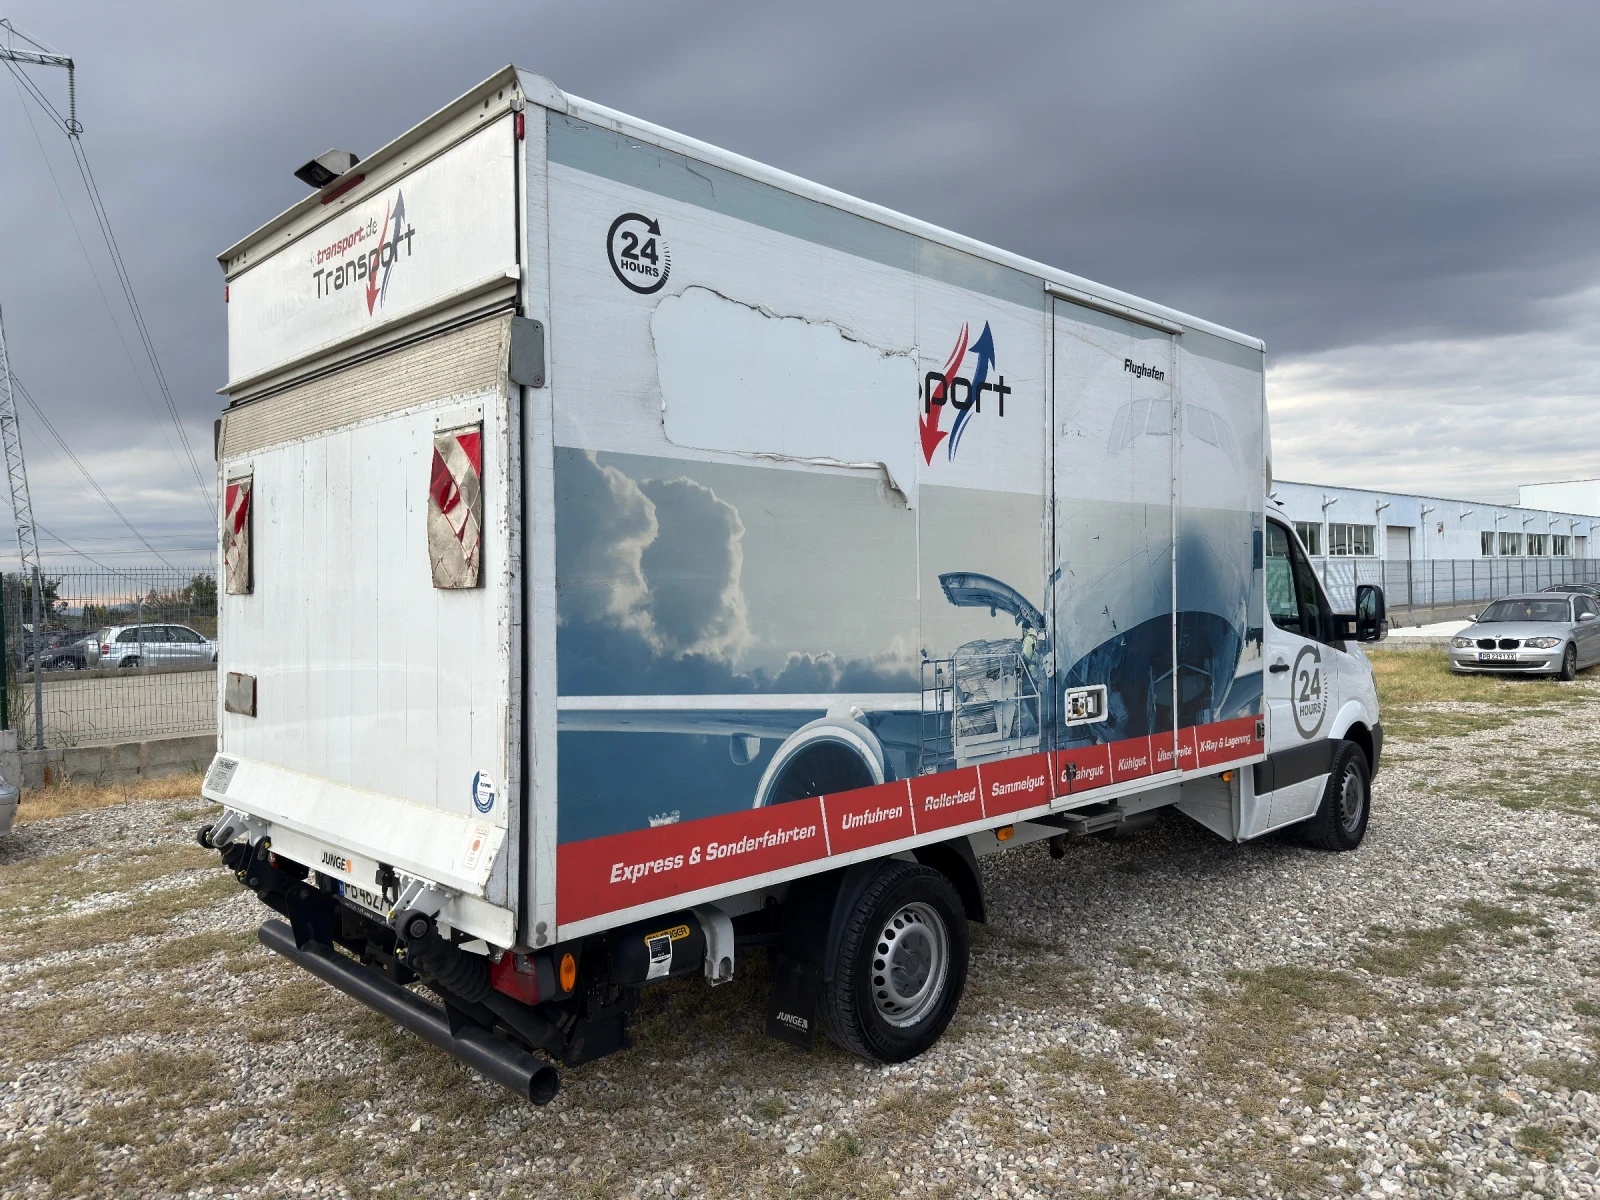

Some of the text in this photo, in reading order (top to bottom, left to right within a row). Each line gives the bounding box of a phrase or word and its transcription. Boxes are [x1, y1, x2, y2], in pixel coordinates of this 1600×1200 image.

[621, 231, 659, 266] 24
[313, 223, 416, 299] Transport
[620, 258, 659, 277] HOURS
[1124, 358, 1165, 382] Flughafen
[919, 371, 1012, 418] port
[1299, 667, 1322, 703] 24
[1299, 702, 1322, 717] HOURS
[1218, 737, 1224, 748] &
[1061, 764, 1105, 783] Gahrgut
[1118, 755, 1147, 772] Kühlgut
[991, 774, 1045, 797] Sammelgut
[924, 786, 976, 812] Rollerbed
[841, 805, 903, 830] Umfuhren
[609, 825, 817, 884] Express & Sonderfahrten
